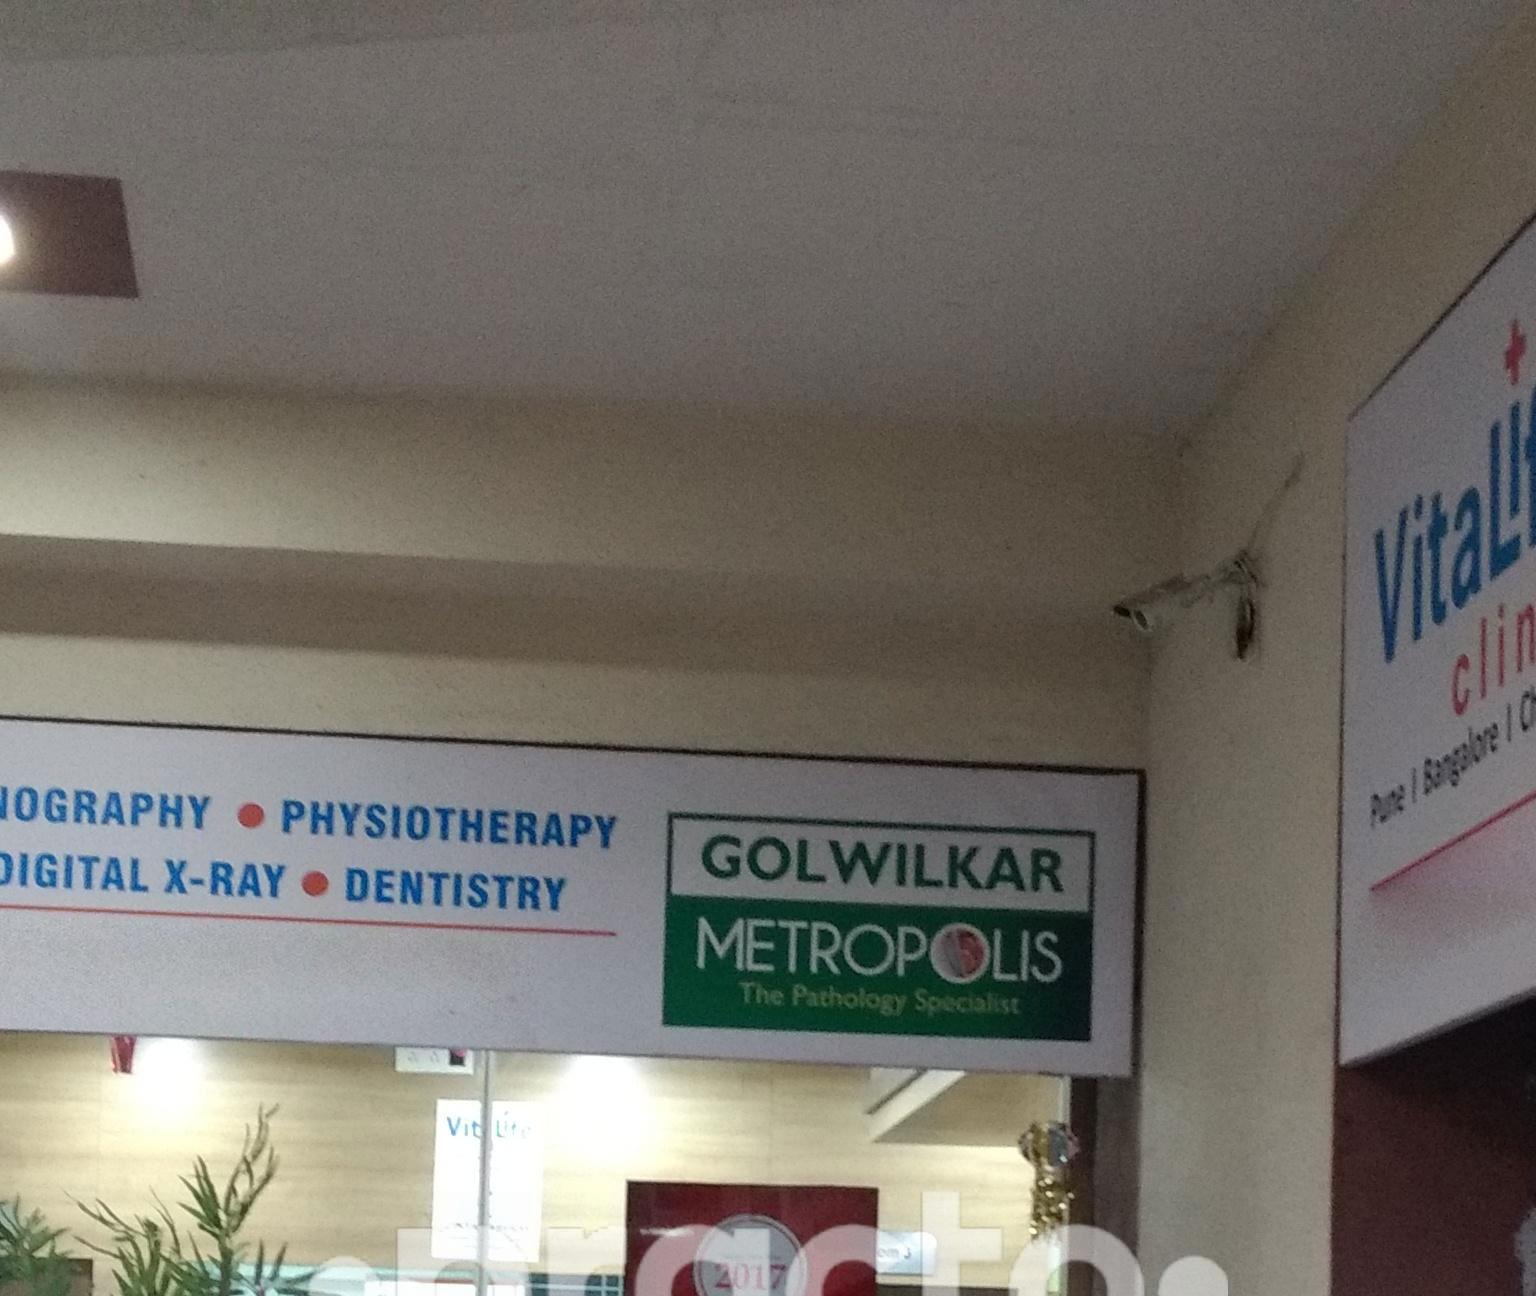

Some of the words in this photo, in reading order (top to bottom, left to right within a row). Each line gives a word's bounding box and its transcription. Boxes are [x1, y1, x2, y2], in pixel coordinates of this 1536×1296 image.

[281, 800, 618, 849] PHYSIOTHERAPY
[165, 860, 285, 898] X-RAY
[345, 869, 568, 911] DENTISTRY
[701, 834, 1063, 893] GOLWILKAR
[696, 917, 1062, 984] METROPOLIS
[740, 981, 784, 1007] The
[792, 984, 905, 1015] Pathology
[915, 989, 1020, 1015] Specialist
[714, 1263, 786, 1290] 2017
